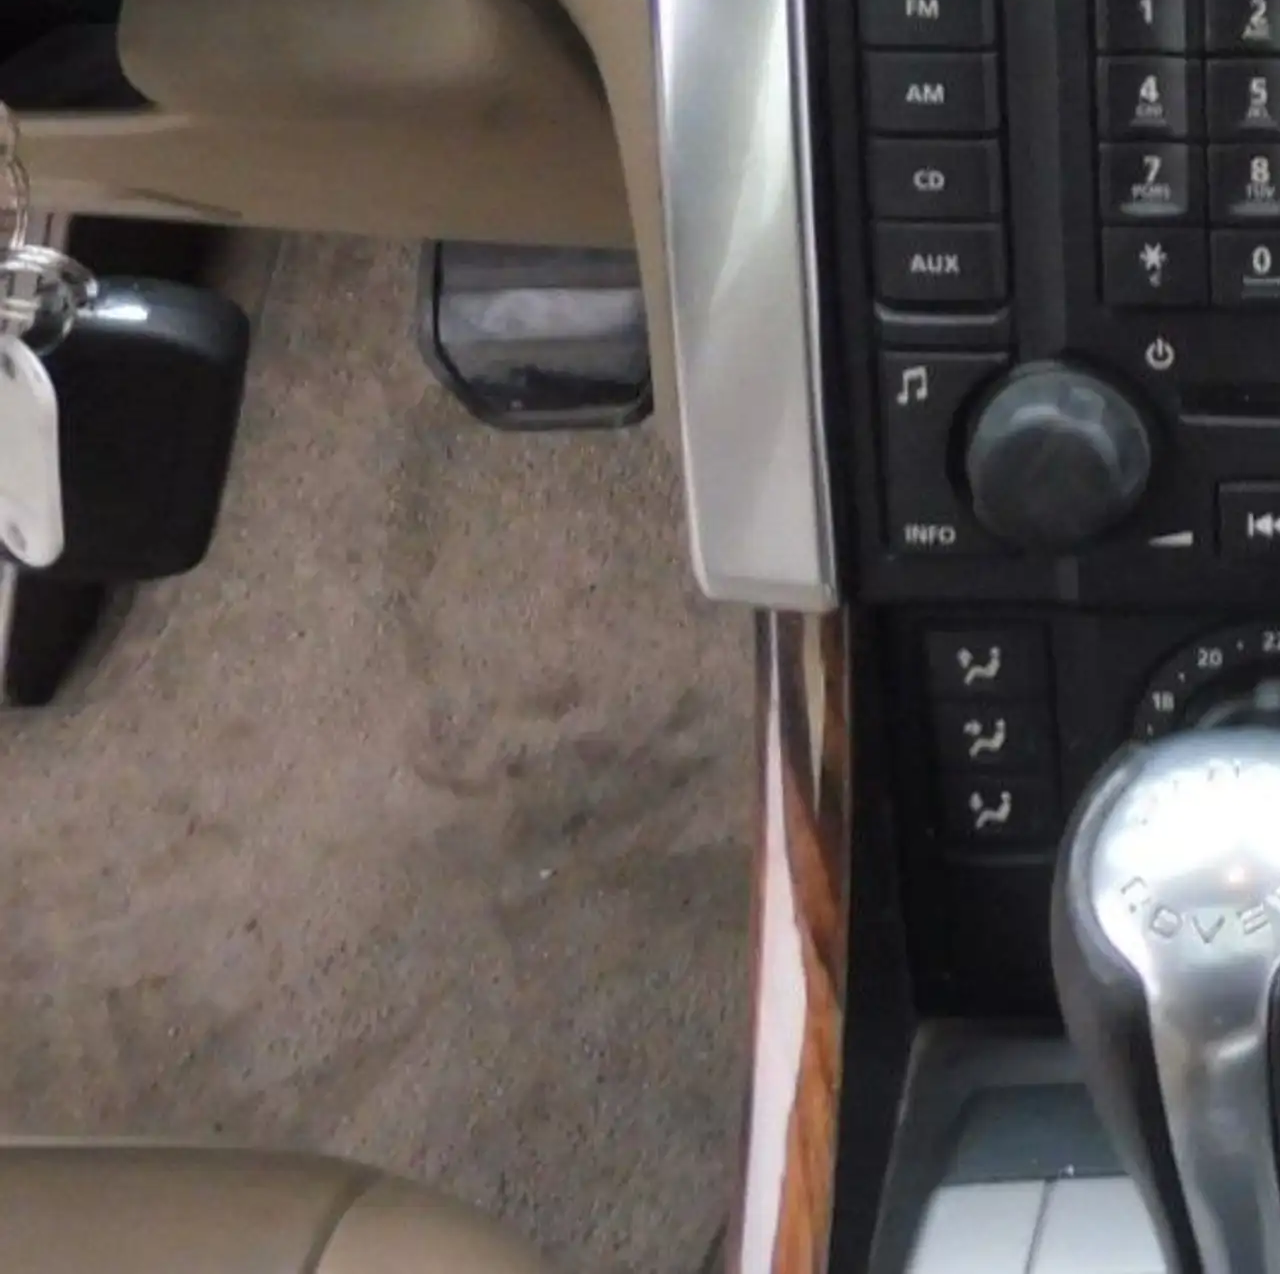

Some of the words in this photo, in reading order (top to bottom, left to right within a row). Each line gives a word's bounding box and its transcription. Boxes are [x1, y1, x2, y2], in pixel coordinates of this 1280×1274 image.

[905, 83, 946, 104] AM
[1139, 74, 1159, 104] 4
[1249, 76, 1268, 105] 5
[912, 170, 946, 191] CD
[1142, 154, 1162, 185] 7
[1250, 155, 1271, 184] 8
[910, 253, 960, 274] AUX
[1252, 244, 1272, 275] 0
[903, 525, 957, 546] INFO
[1197, 645, 1223, 668] 20
